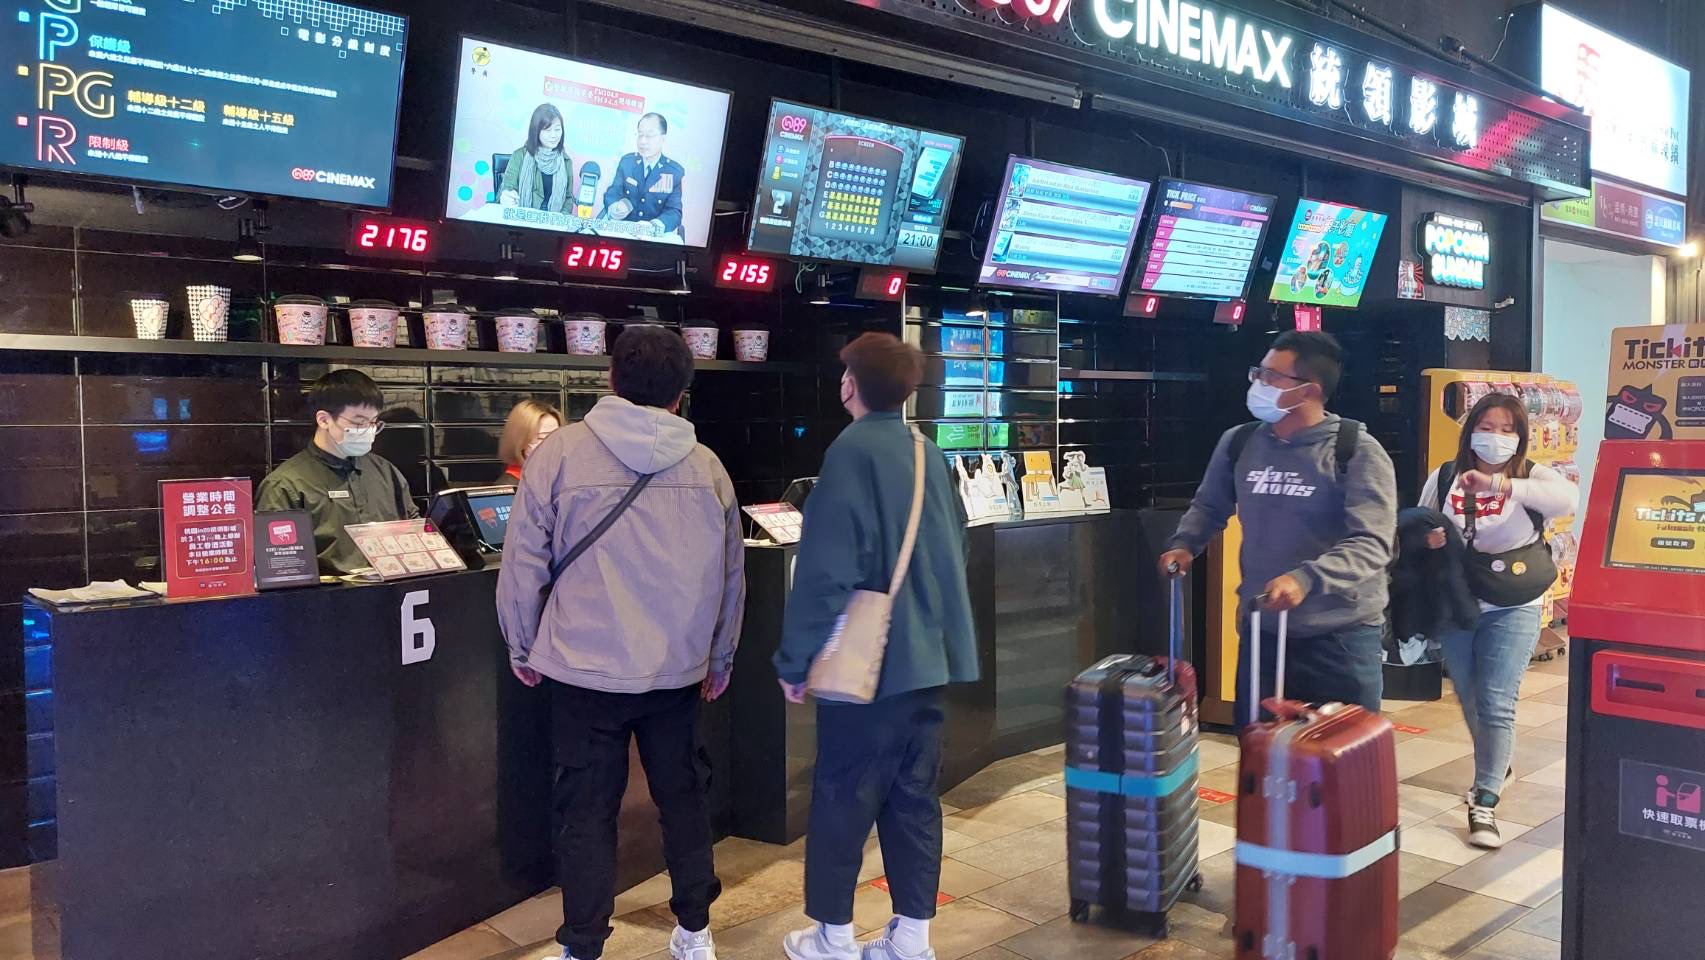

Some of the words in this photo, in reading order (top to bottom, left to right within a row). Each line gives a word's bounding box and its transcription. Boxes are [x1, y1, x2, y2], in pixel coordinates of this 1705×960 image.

[38, 12, 79, 62] P
[88, 34, 131, 54] 保護級
[1094, 0, 1293, 89] CINEMAX
[38, 63, 115, 119] PG
[127, 90, 206, 113] 輔導級十二級
[223, 104, 295, 127] 輔導級十五級
[38, 115, 77, 165] R
[88, 135, 129, 152] 限制級
[315, 170, 375, 189] CINEMAX
[360, 224, 429, 251] 2176
[903, 232, 934, 247] 21:00
[567, 246, 623, 270] 2175
[723, 262, 770, 284] 2155
[888, 278, 901, 295] 0
[1146, 298, 1155, 312] 0
[1233, 306, 1242, 319] 0
[1622, 360, 1685, 370] MONSTER
[182, 490, 236, 504] 營業時間
[183, 503, 236, 517] 調整公告
[400, 590, 436, 665] 6
